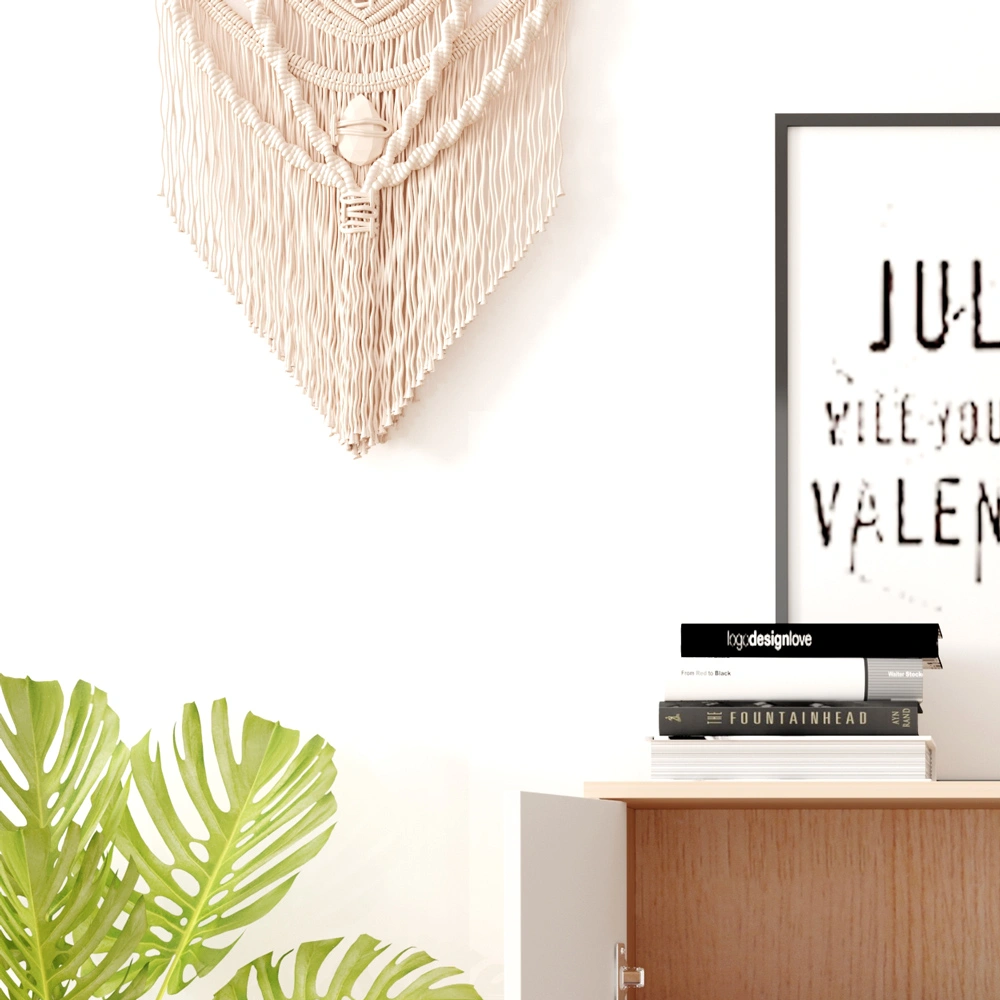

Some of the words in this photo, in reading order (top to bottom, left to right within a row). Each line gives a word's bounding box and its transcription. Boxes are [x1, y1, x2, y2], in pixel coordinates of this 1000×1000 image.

[681, 669, 695, 677] From
[714, 669, 732, 677] Black
[730, 711, 867, 725] FOUNTAINHEAD
[891, 710, 900, 725] AYN
[902, 708, 911, 728] RAND
